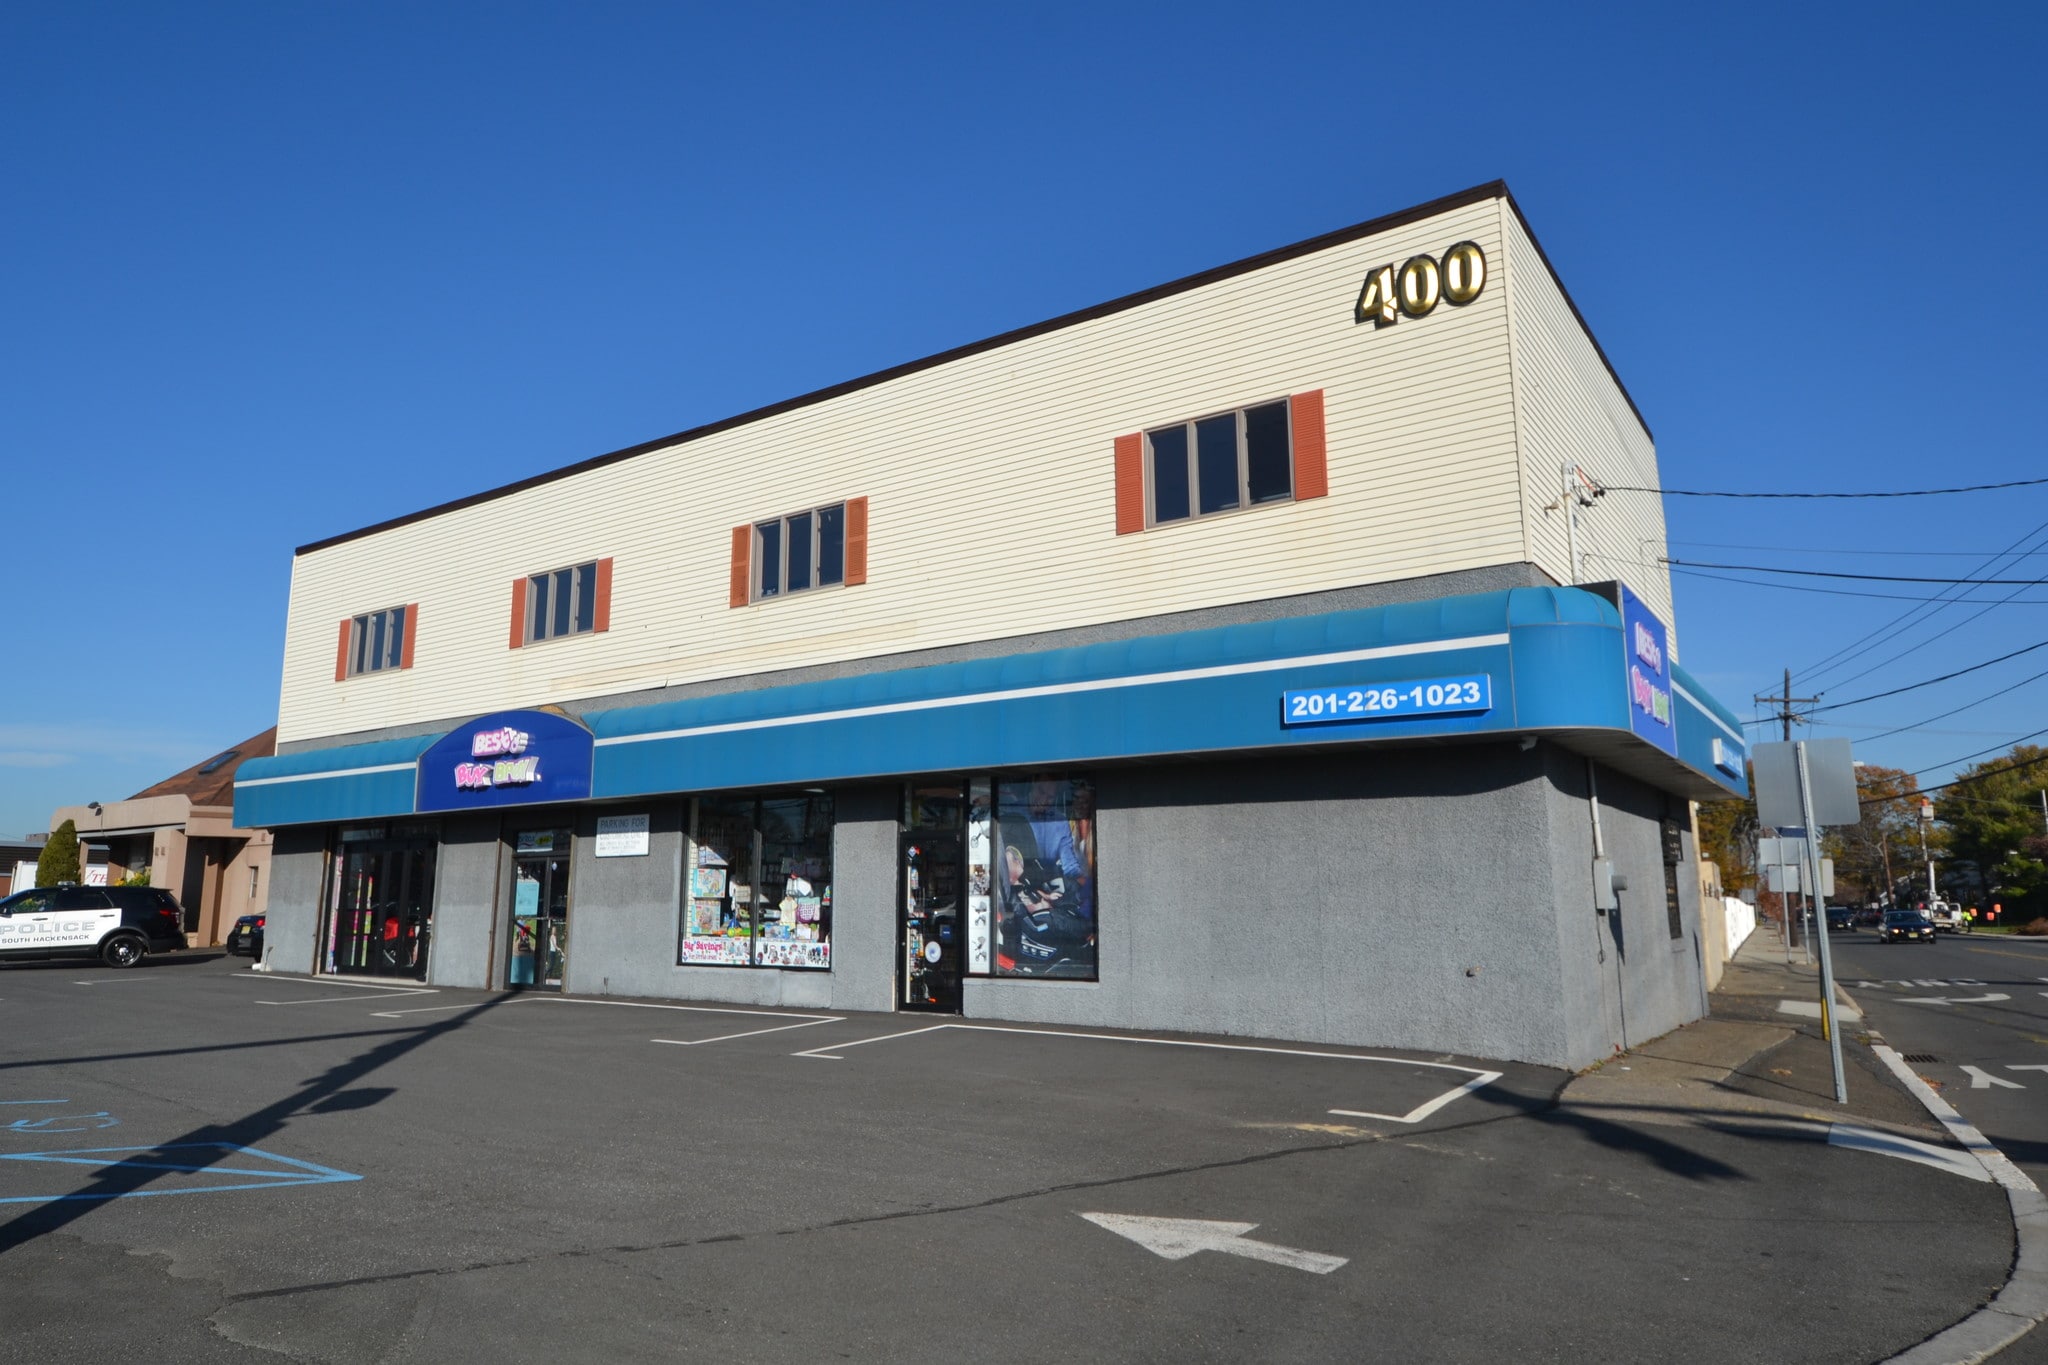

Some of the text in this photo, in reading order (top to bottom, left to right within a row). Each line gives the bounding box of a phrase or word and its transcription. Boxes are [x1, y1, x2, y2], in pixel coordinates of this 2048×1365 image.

[1354, 240, 1487, 331] 400
[1292, 681, 1481, 717] 201-226-1023
[455, 763, 491, 788] BUY
[600, 817, 646, 829] PARKING FOR
[0, 921, 96, 935] POLICE
[33, 934, 90, 943] HACKENSACK
